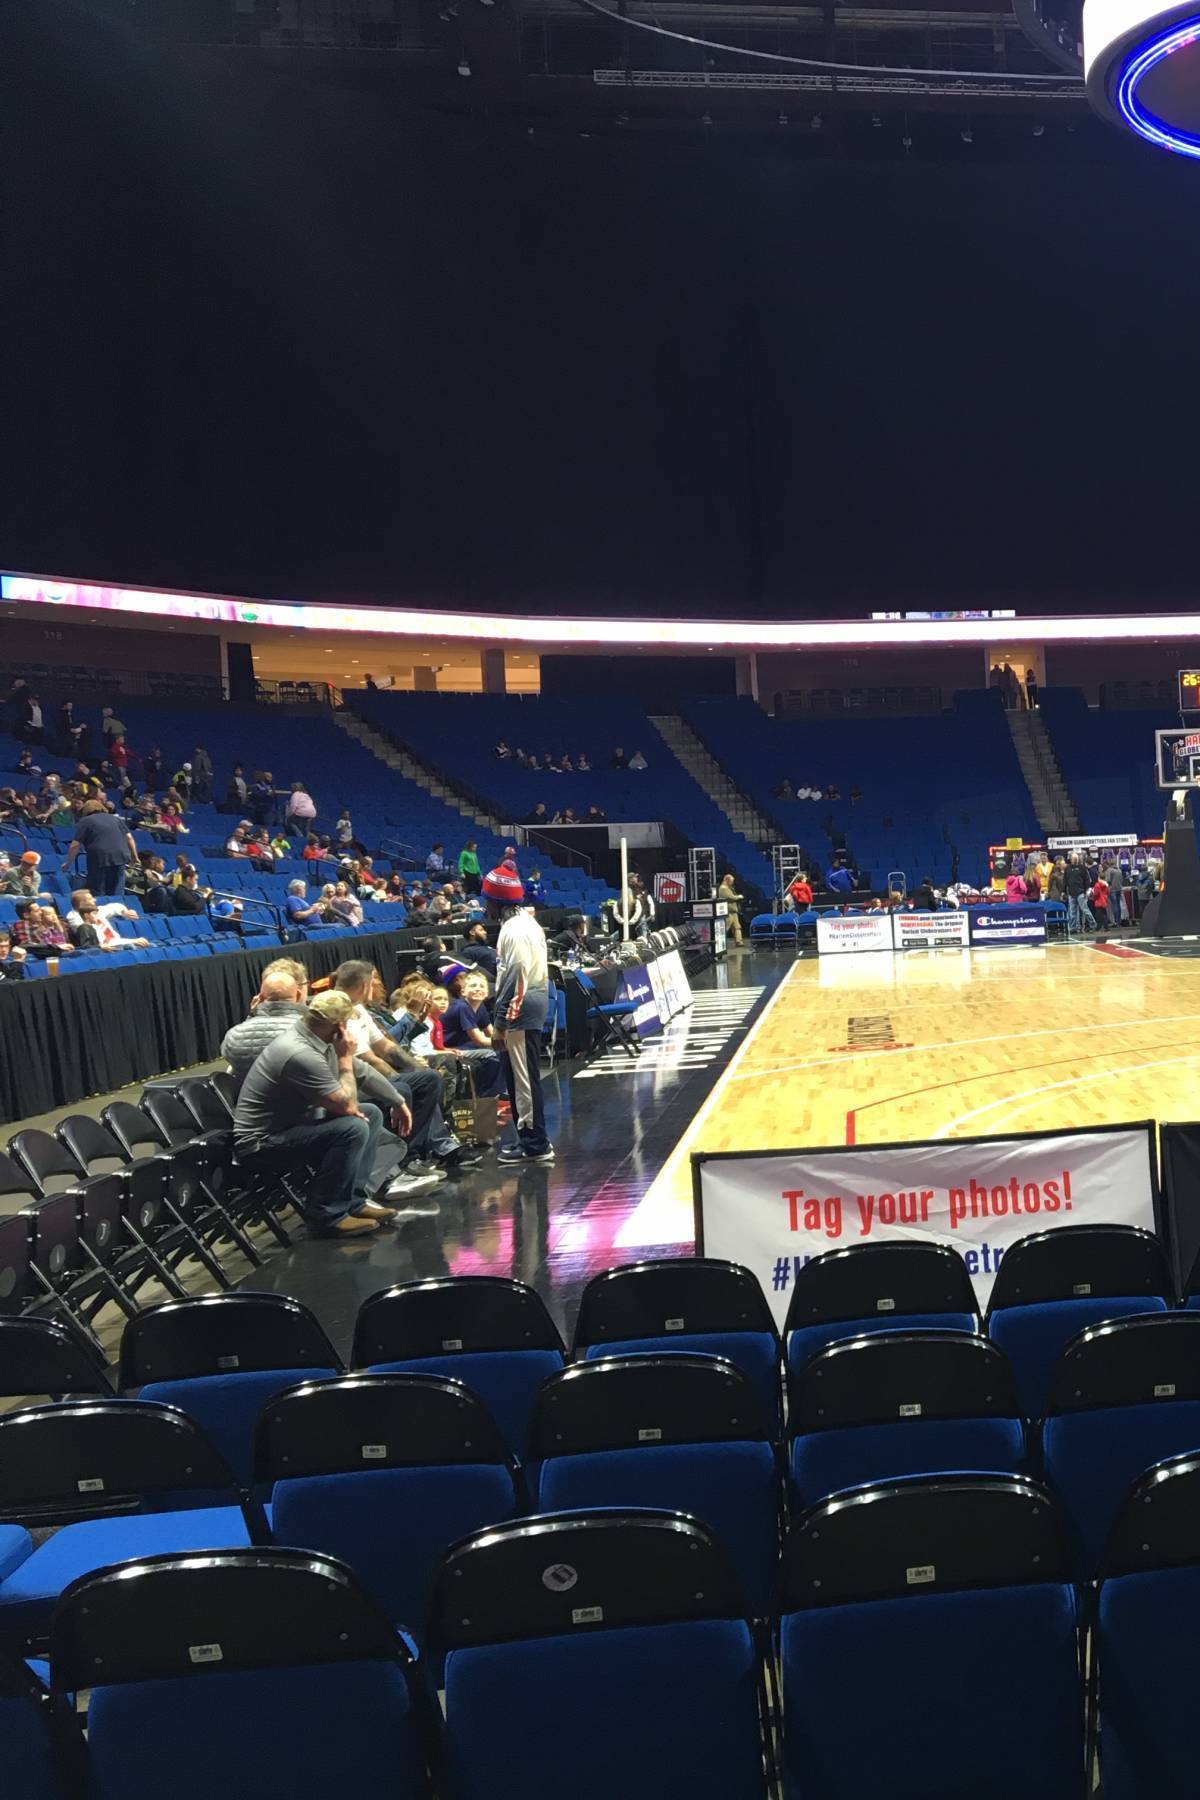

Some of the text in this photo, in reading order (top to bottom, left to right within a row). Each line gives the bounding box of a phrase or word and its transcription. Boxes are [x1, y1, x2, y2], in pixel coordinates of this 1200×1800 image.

[977, 916, 1038, 927] Champion
[782, 1171, 1073, 1239] Tag your photos!
